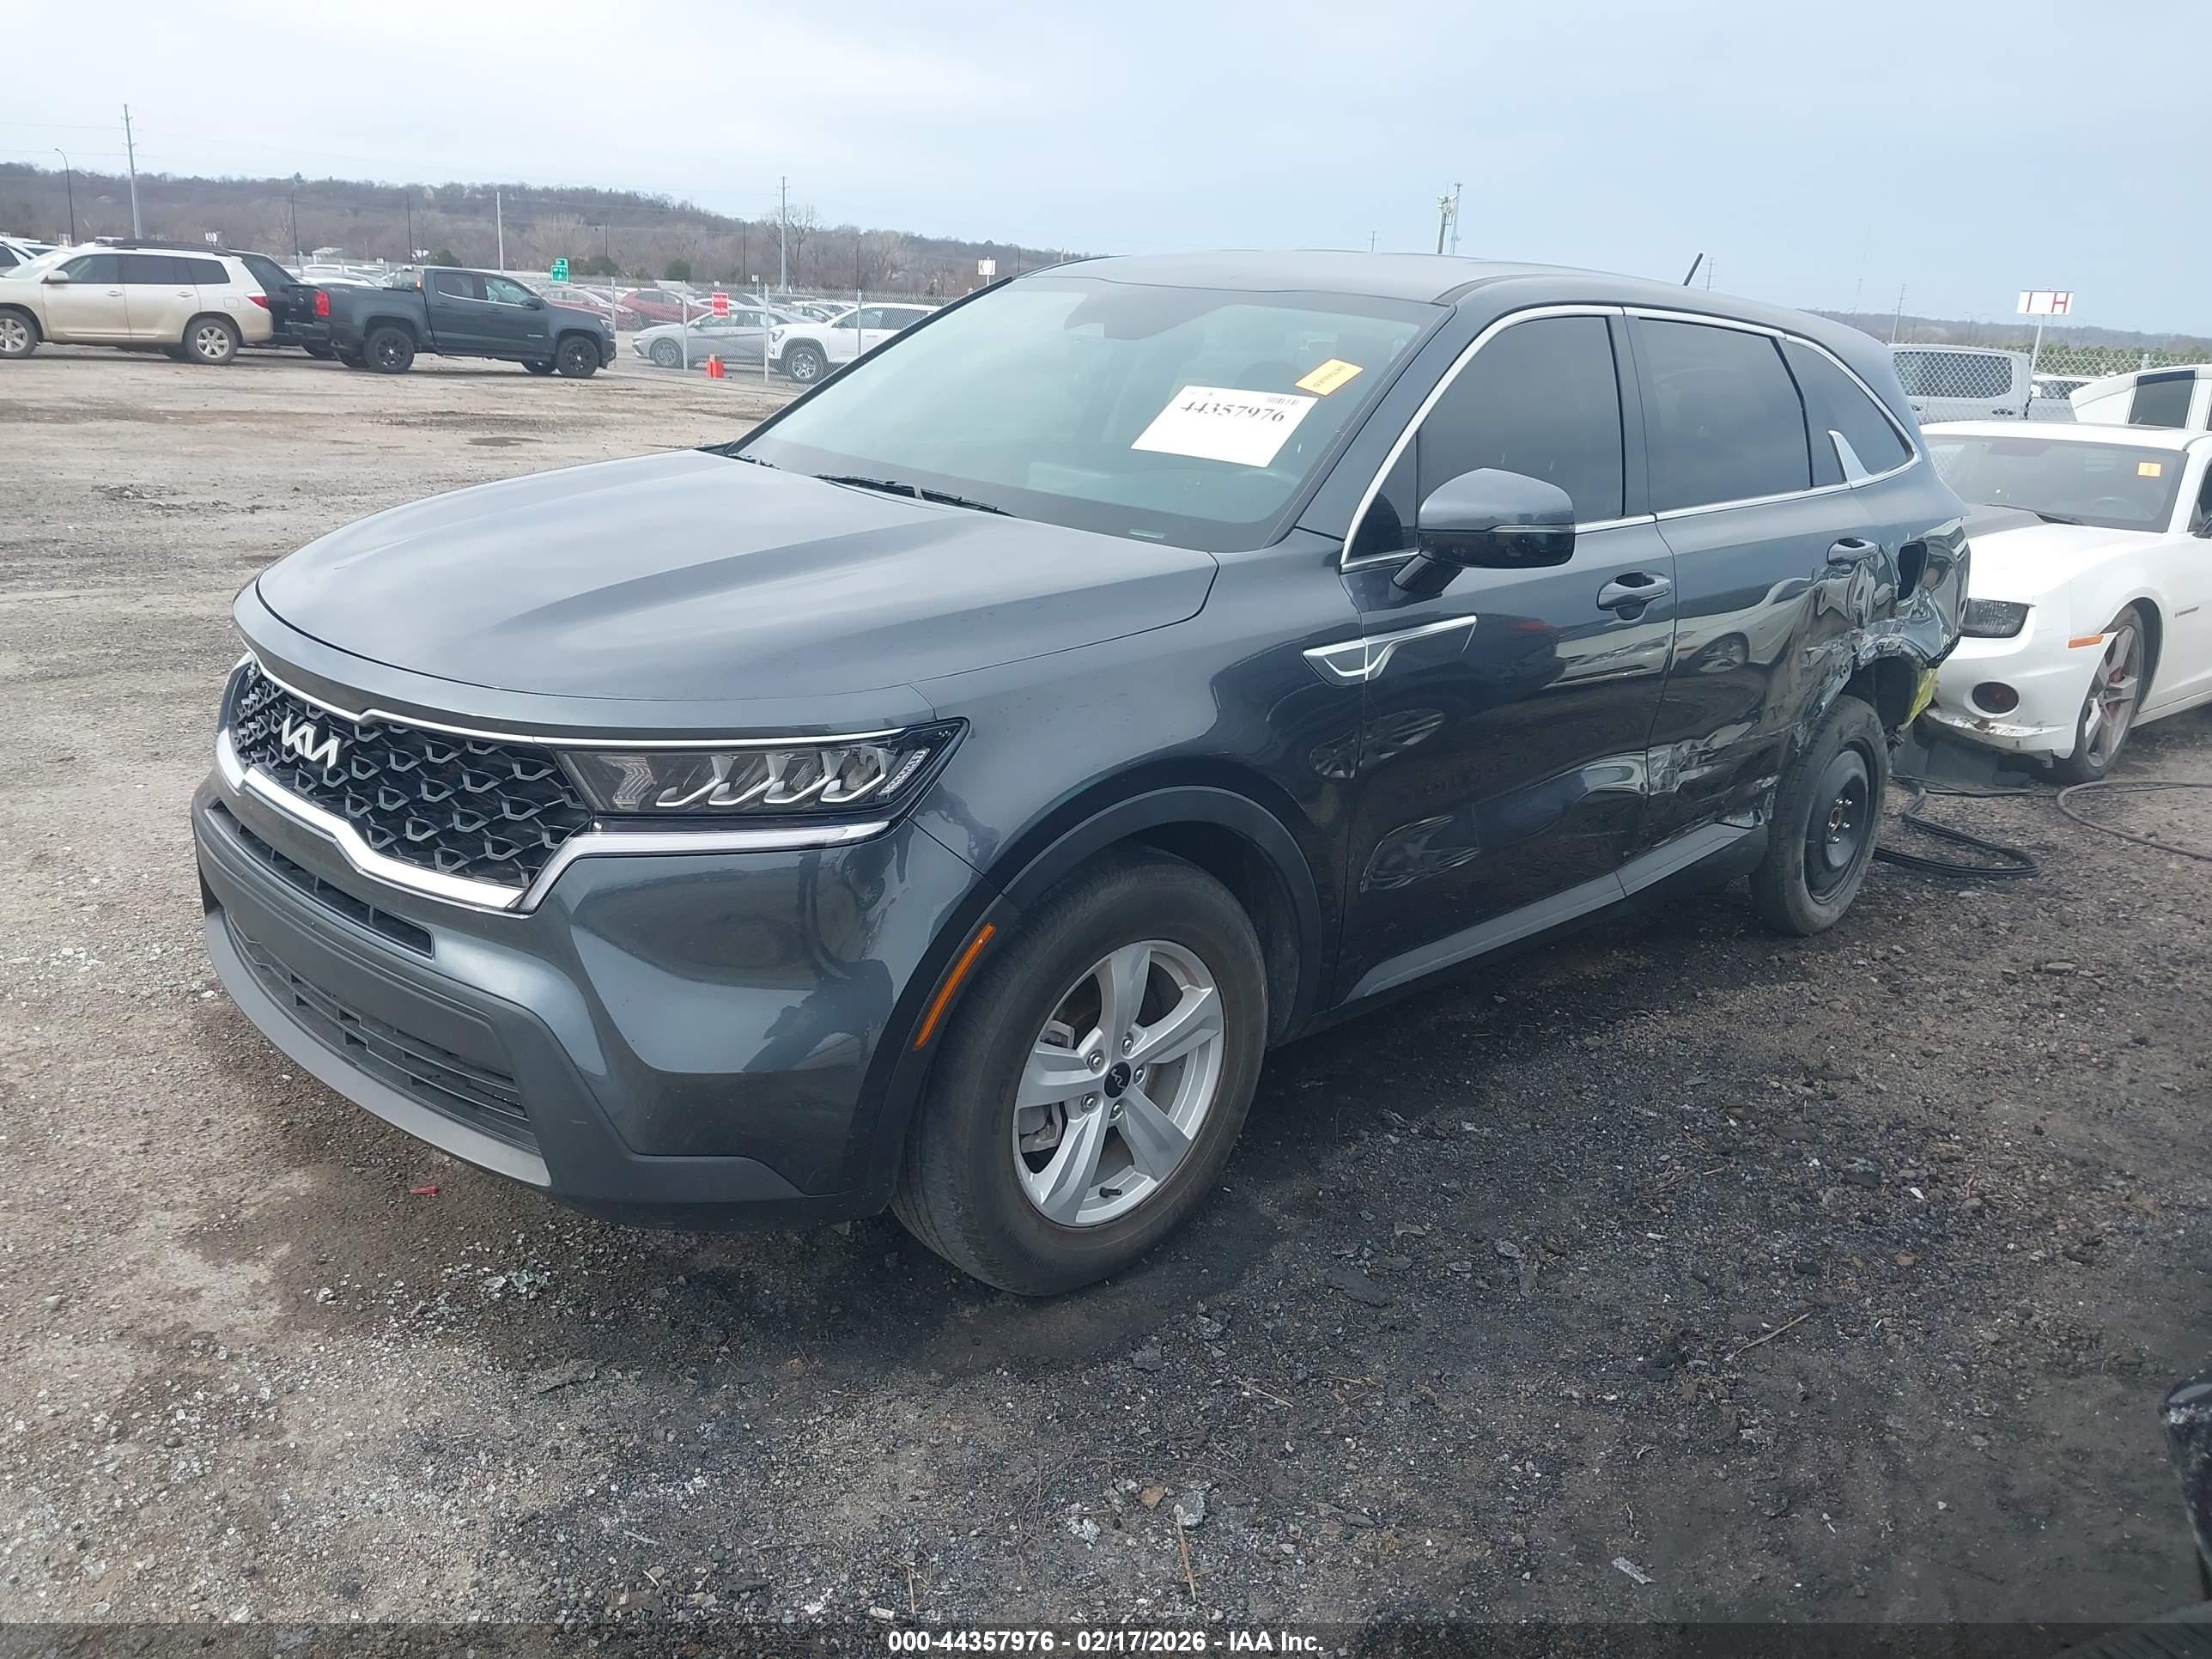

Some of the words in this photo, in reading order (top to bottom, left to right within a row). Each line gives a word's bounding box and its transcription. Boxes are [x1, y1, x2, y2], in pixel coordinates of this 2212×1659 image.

[2051, 292, 2069, 313] H
[1181, 401, 1285, 422] 44357976
[282, 714, 341, 769] KIA
